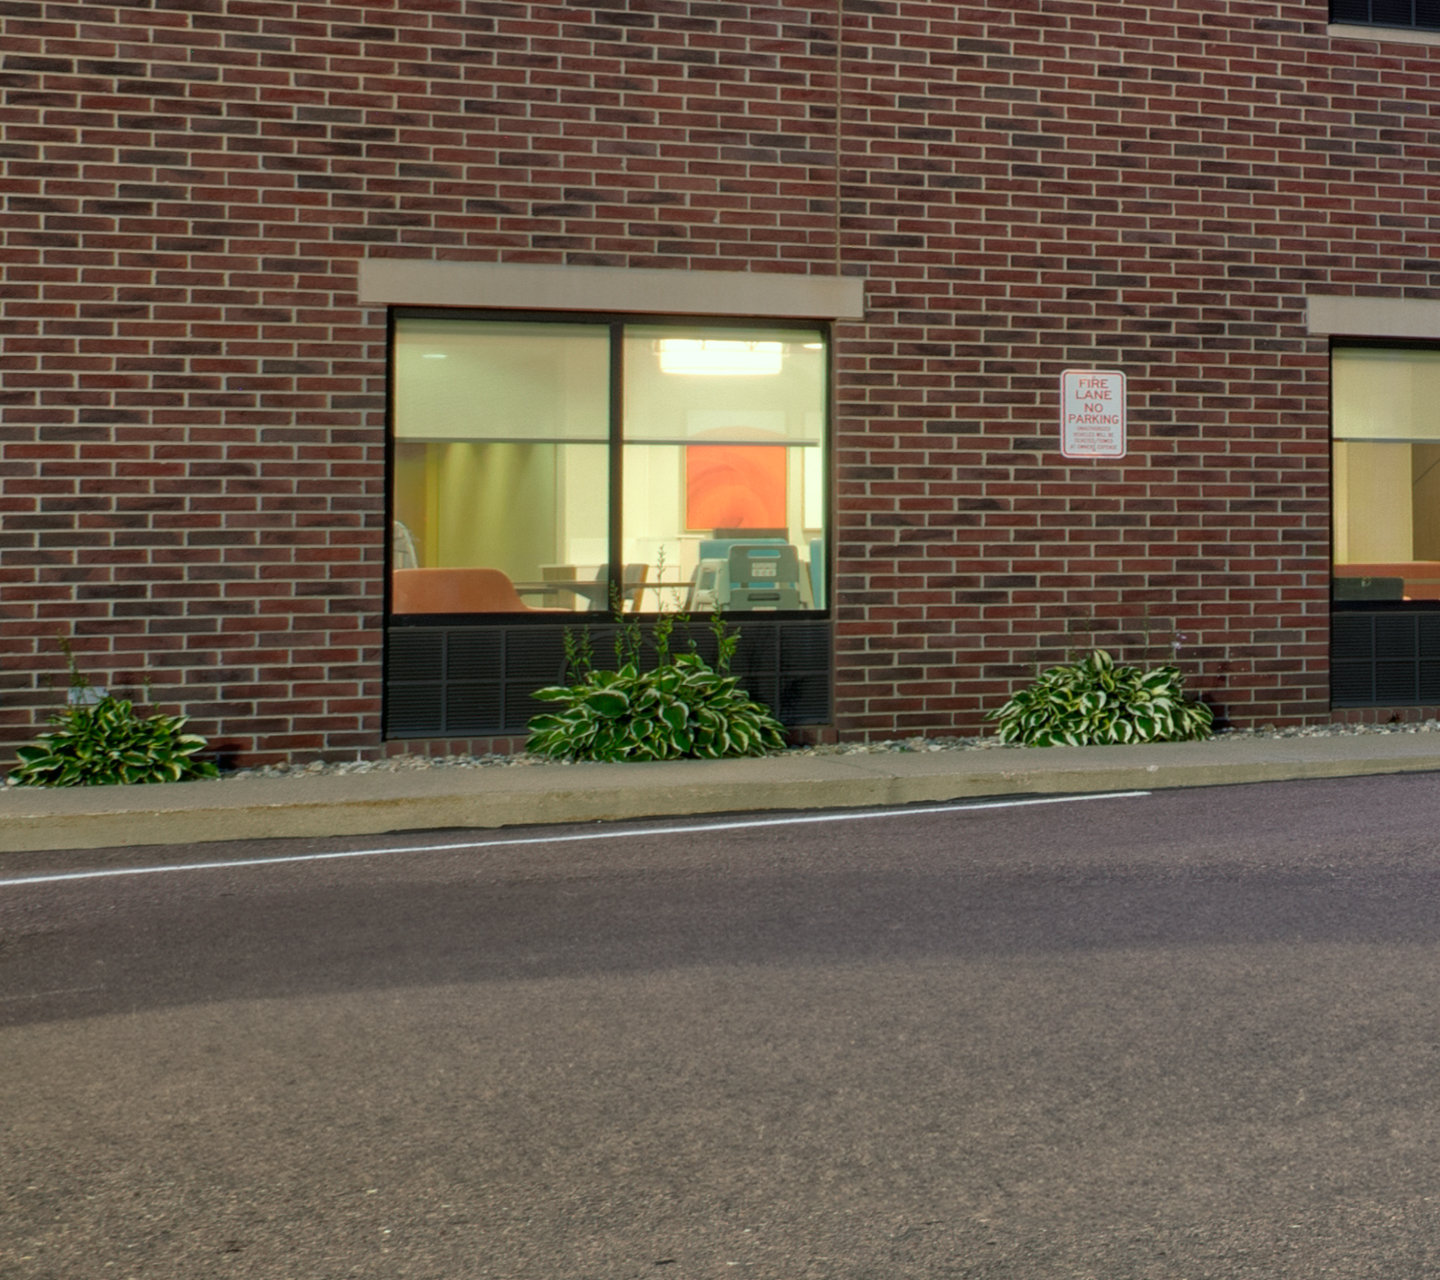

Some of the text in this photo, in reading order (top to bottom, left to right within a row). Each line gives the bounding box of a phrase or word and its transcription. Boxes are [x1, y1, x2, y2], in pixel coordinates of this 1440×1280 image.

[1078, 378, 1110, 389] FIRE
[1075, 389, 1112, 400] LANE
[1083, 402, 1104, 413] NO
[1068, 413, 1120, 425] PARKING
